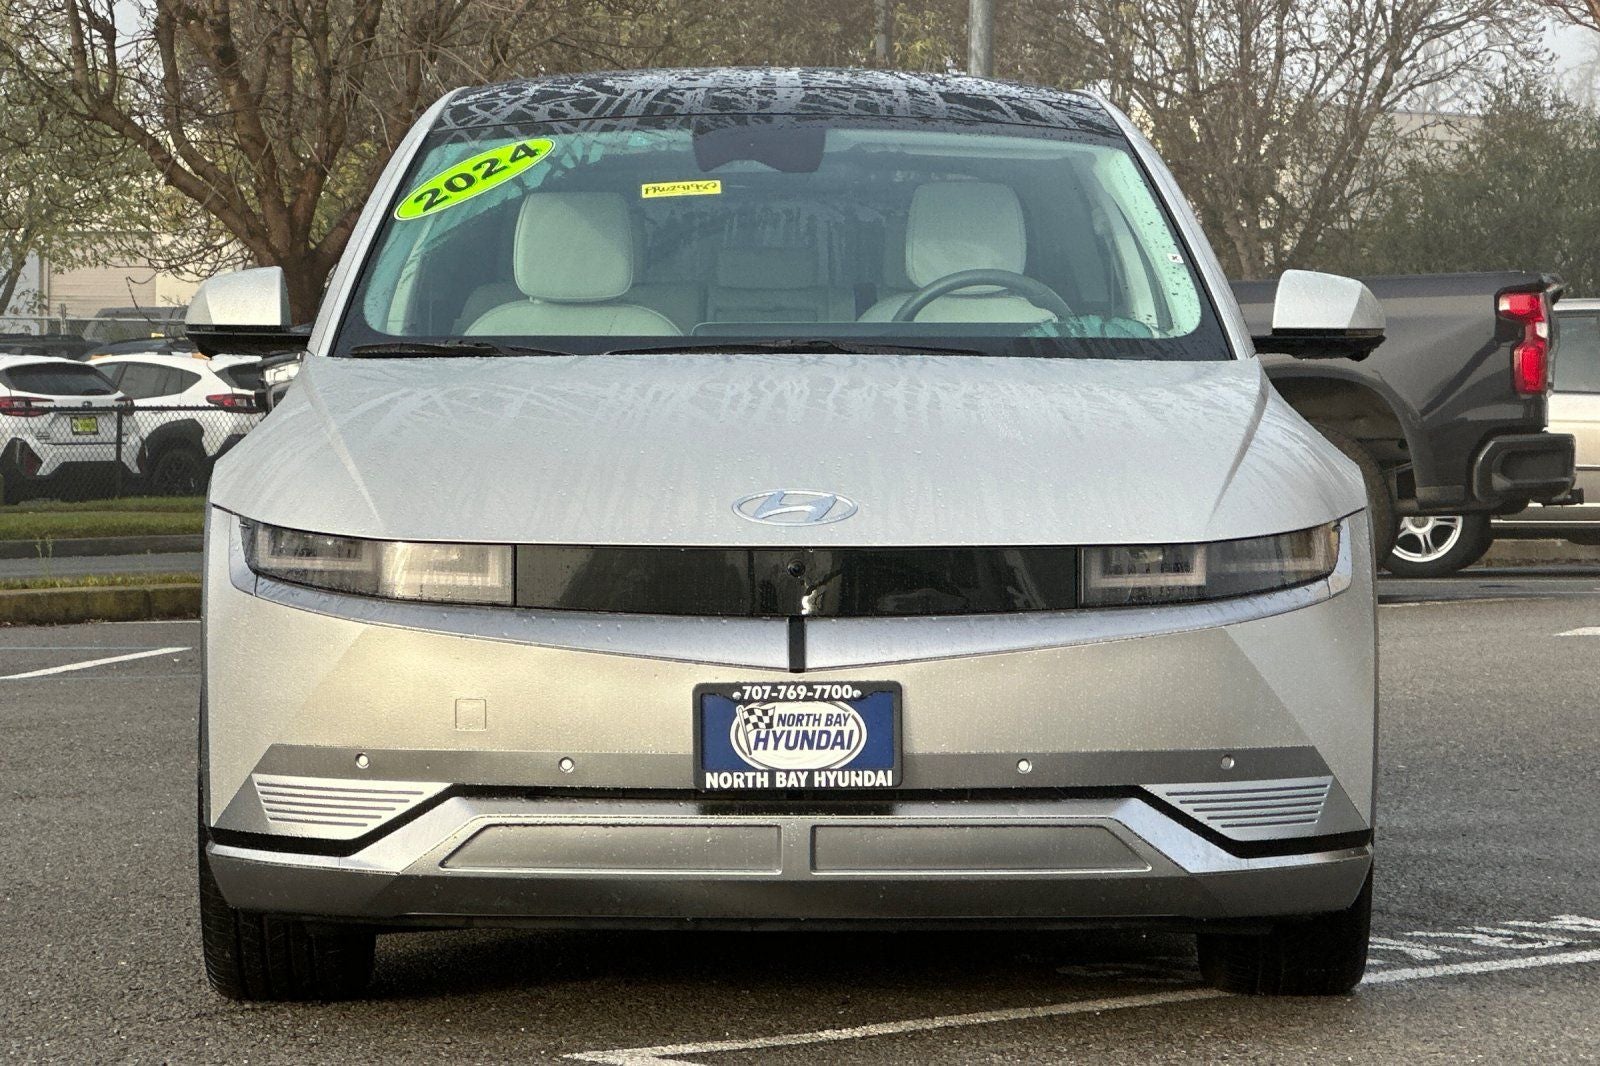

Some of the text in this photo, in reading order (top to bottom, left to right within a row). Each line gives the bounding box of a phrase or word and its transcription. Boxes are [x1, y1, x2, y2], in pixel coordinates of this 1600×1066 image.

[413, 142, 542, 213] 2024
[742, 685, 853, 700] 707-769-7700
[776, 713, 852, 728] NORTH BAY
[752, 729, 855, 751] HYUNDAI
[705, 770, 893, 789] NORTH BAY HYUNDAI
